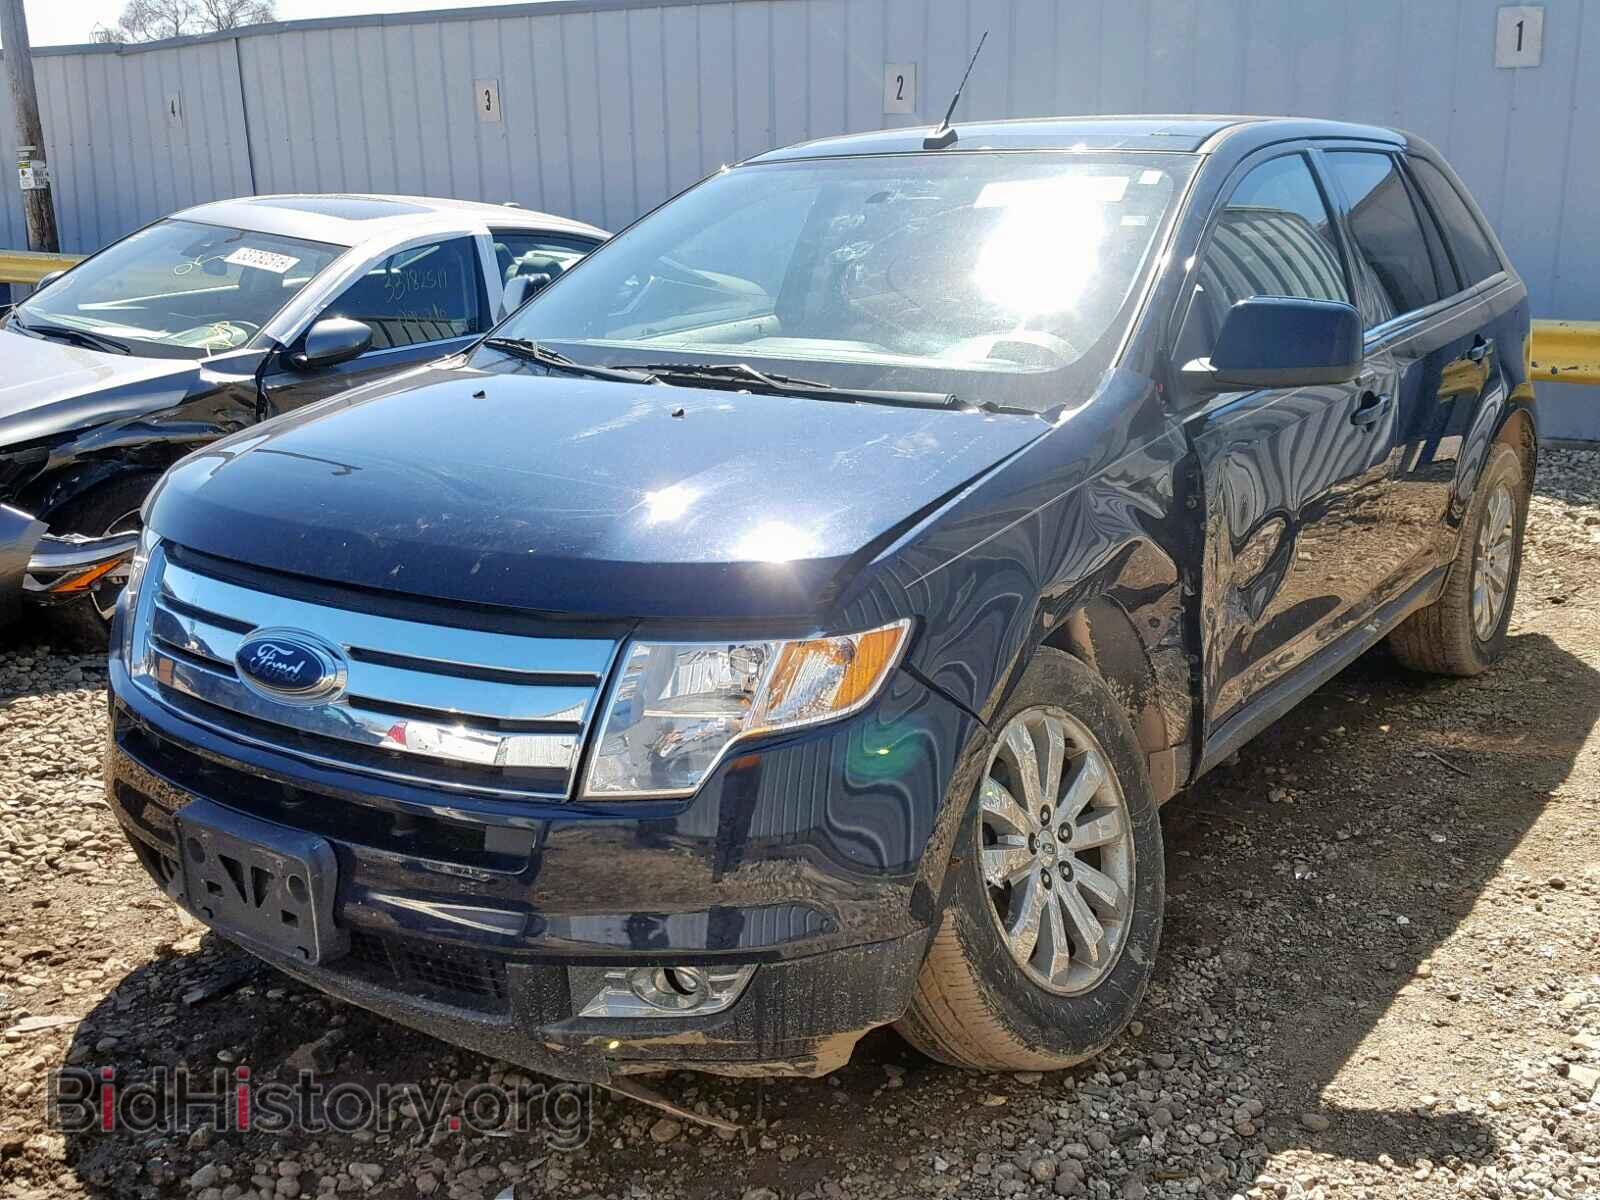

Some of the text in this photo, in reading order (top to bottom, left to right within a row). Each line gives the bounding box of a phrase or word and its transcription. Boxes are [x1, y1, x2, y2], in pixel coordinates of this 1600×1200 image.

[1516, 20, 1524, 52] 1
[484, 89, 491, 111] 3
[895, 74, 904, 101] 2
[250, 643, 306, 681] Ford
